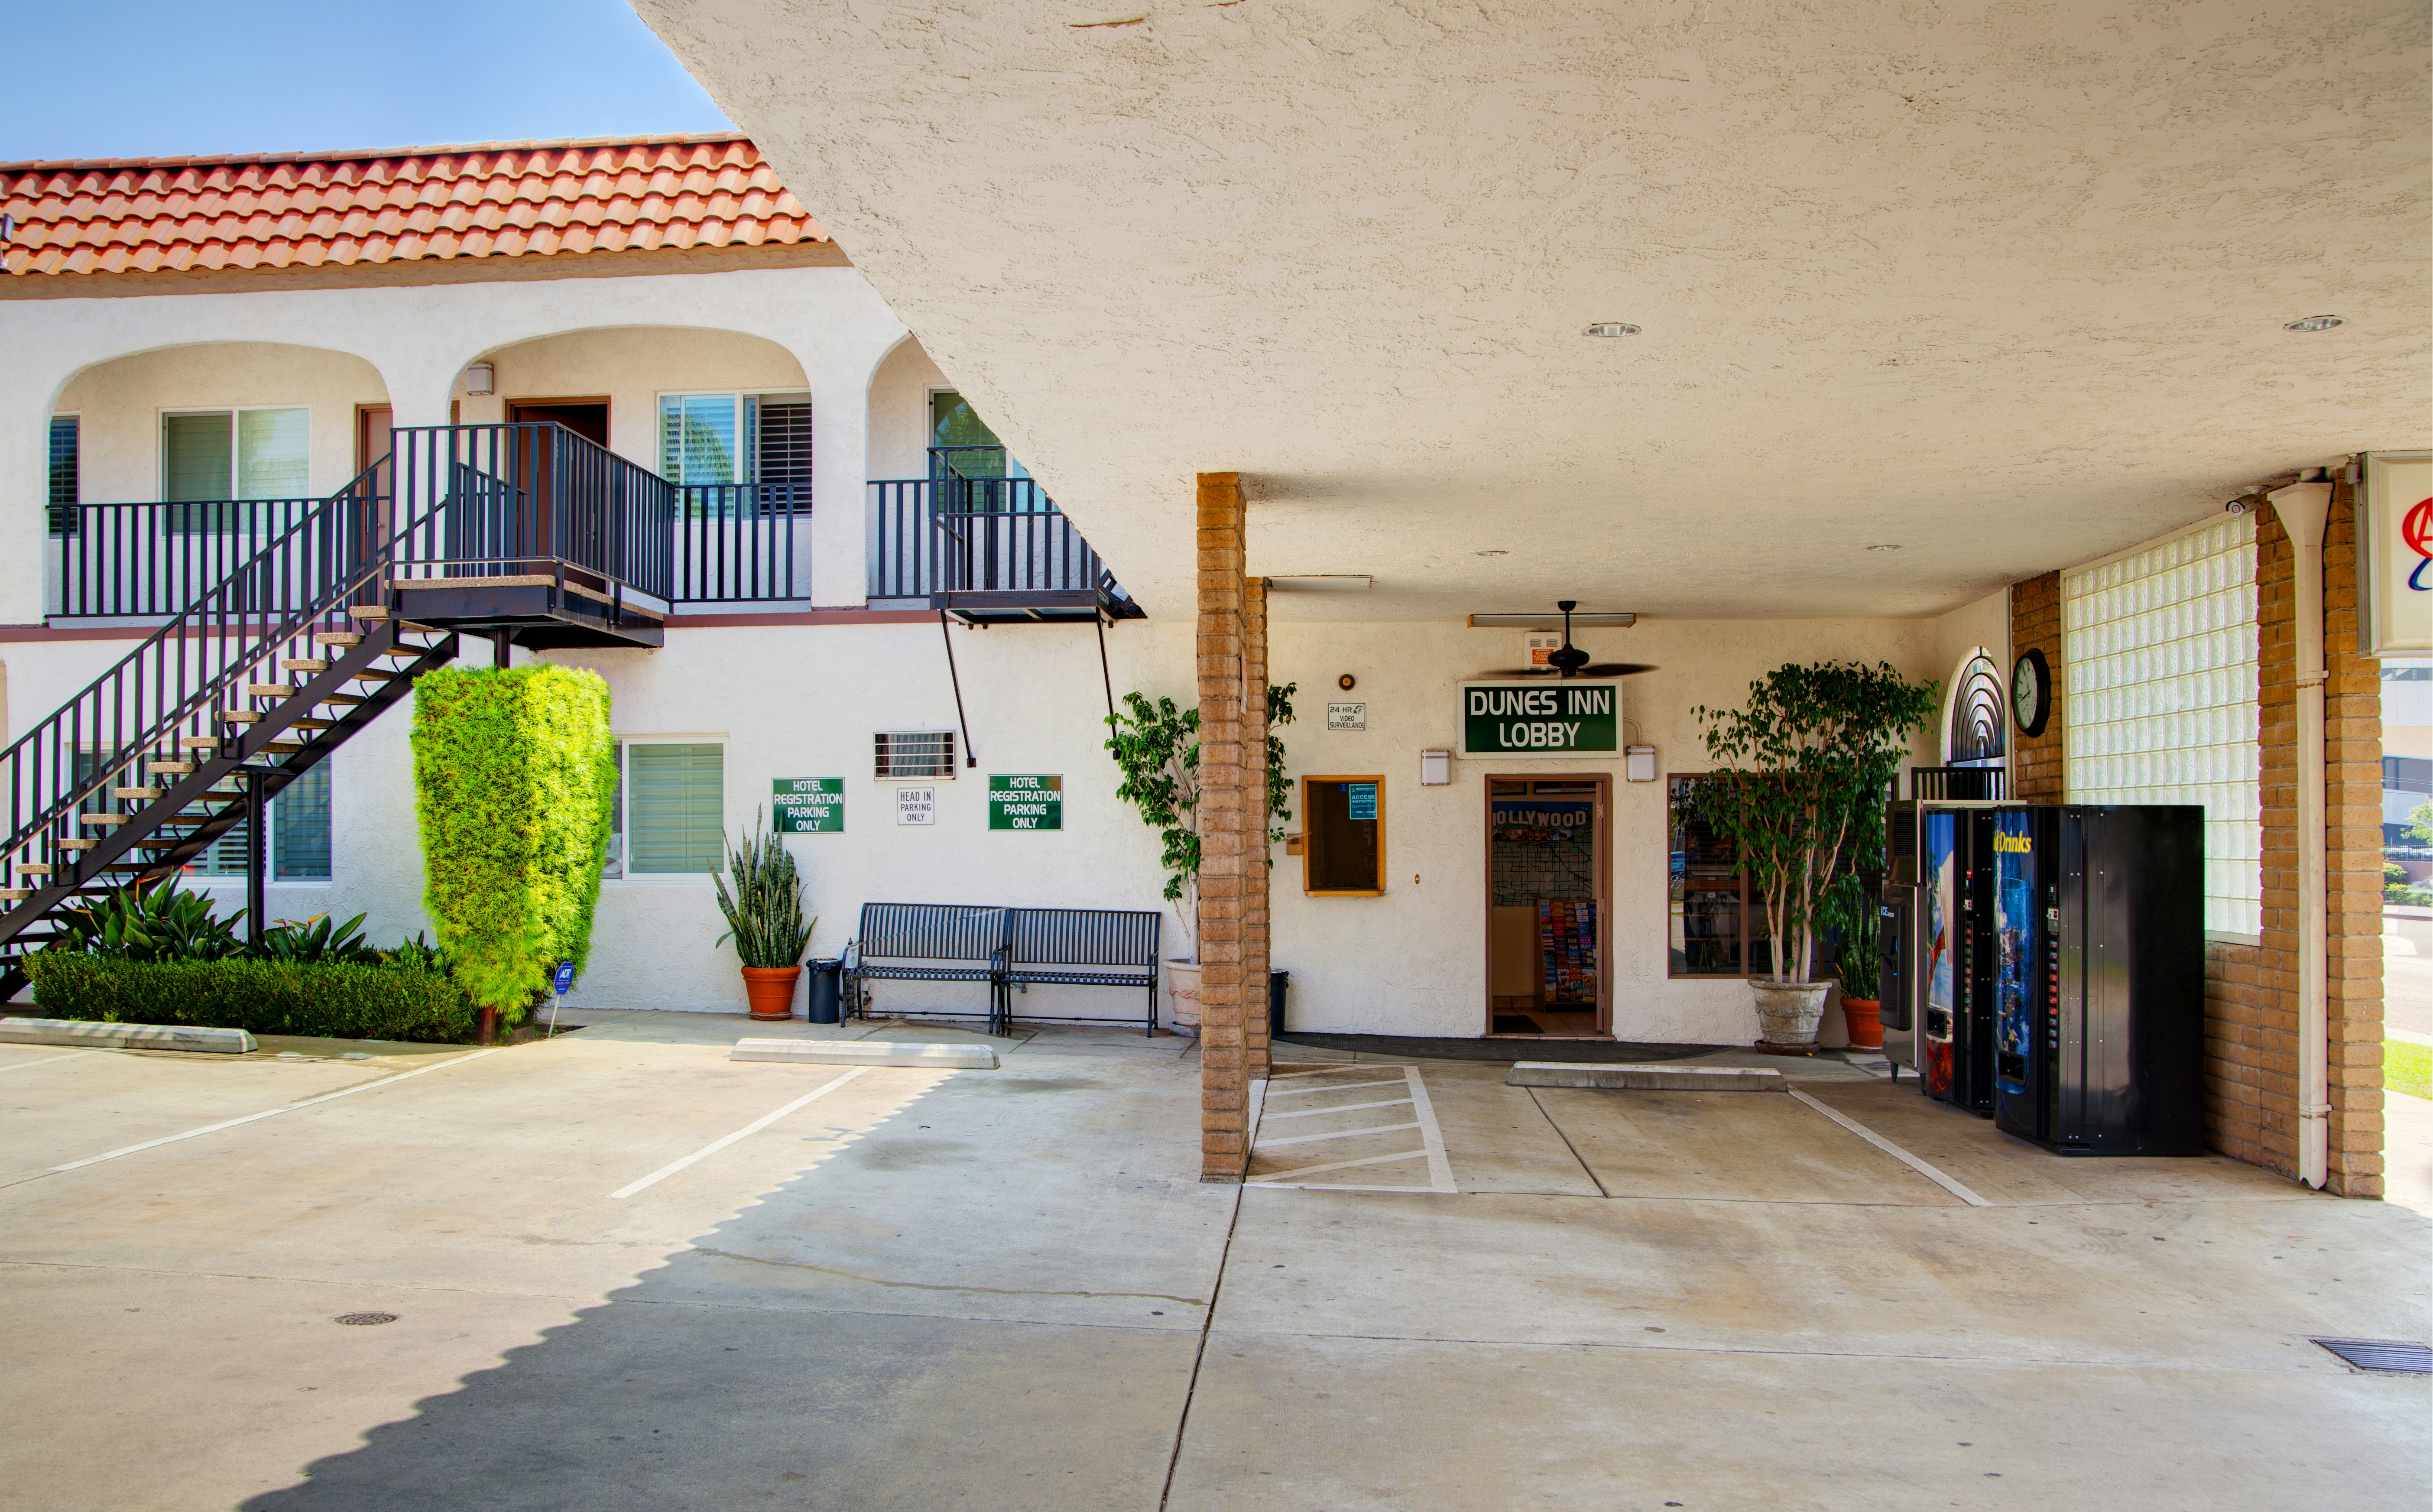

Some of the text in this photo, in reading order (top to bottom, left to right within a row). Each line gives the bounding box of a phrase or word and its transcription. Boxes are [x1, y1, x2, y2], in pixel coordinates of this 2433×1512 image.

[1471, 690, 1609, 715] DUNES INN
[1499, 722, 1580, 747] LOBBY
[793, 780, 823, 791] HOTEL
[1010, 777, 1040, 788] HOTEL
[774, 793, 843, 805] REGISTRATION
[900, 791, 931, 801] HEAD IN
[990, 791, 1060, 801] REGISTRATION
[788, 807, 829, 818] PARKING
[1004, 804, 1047, 815] PARKING
[796, 820, 821, 831] ONLY
[1012, 818, 1038, 828] ONLY
[1999, 830, 2032, 853] Drinks
[560, 968, 571, 978] ADT
